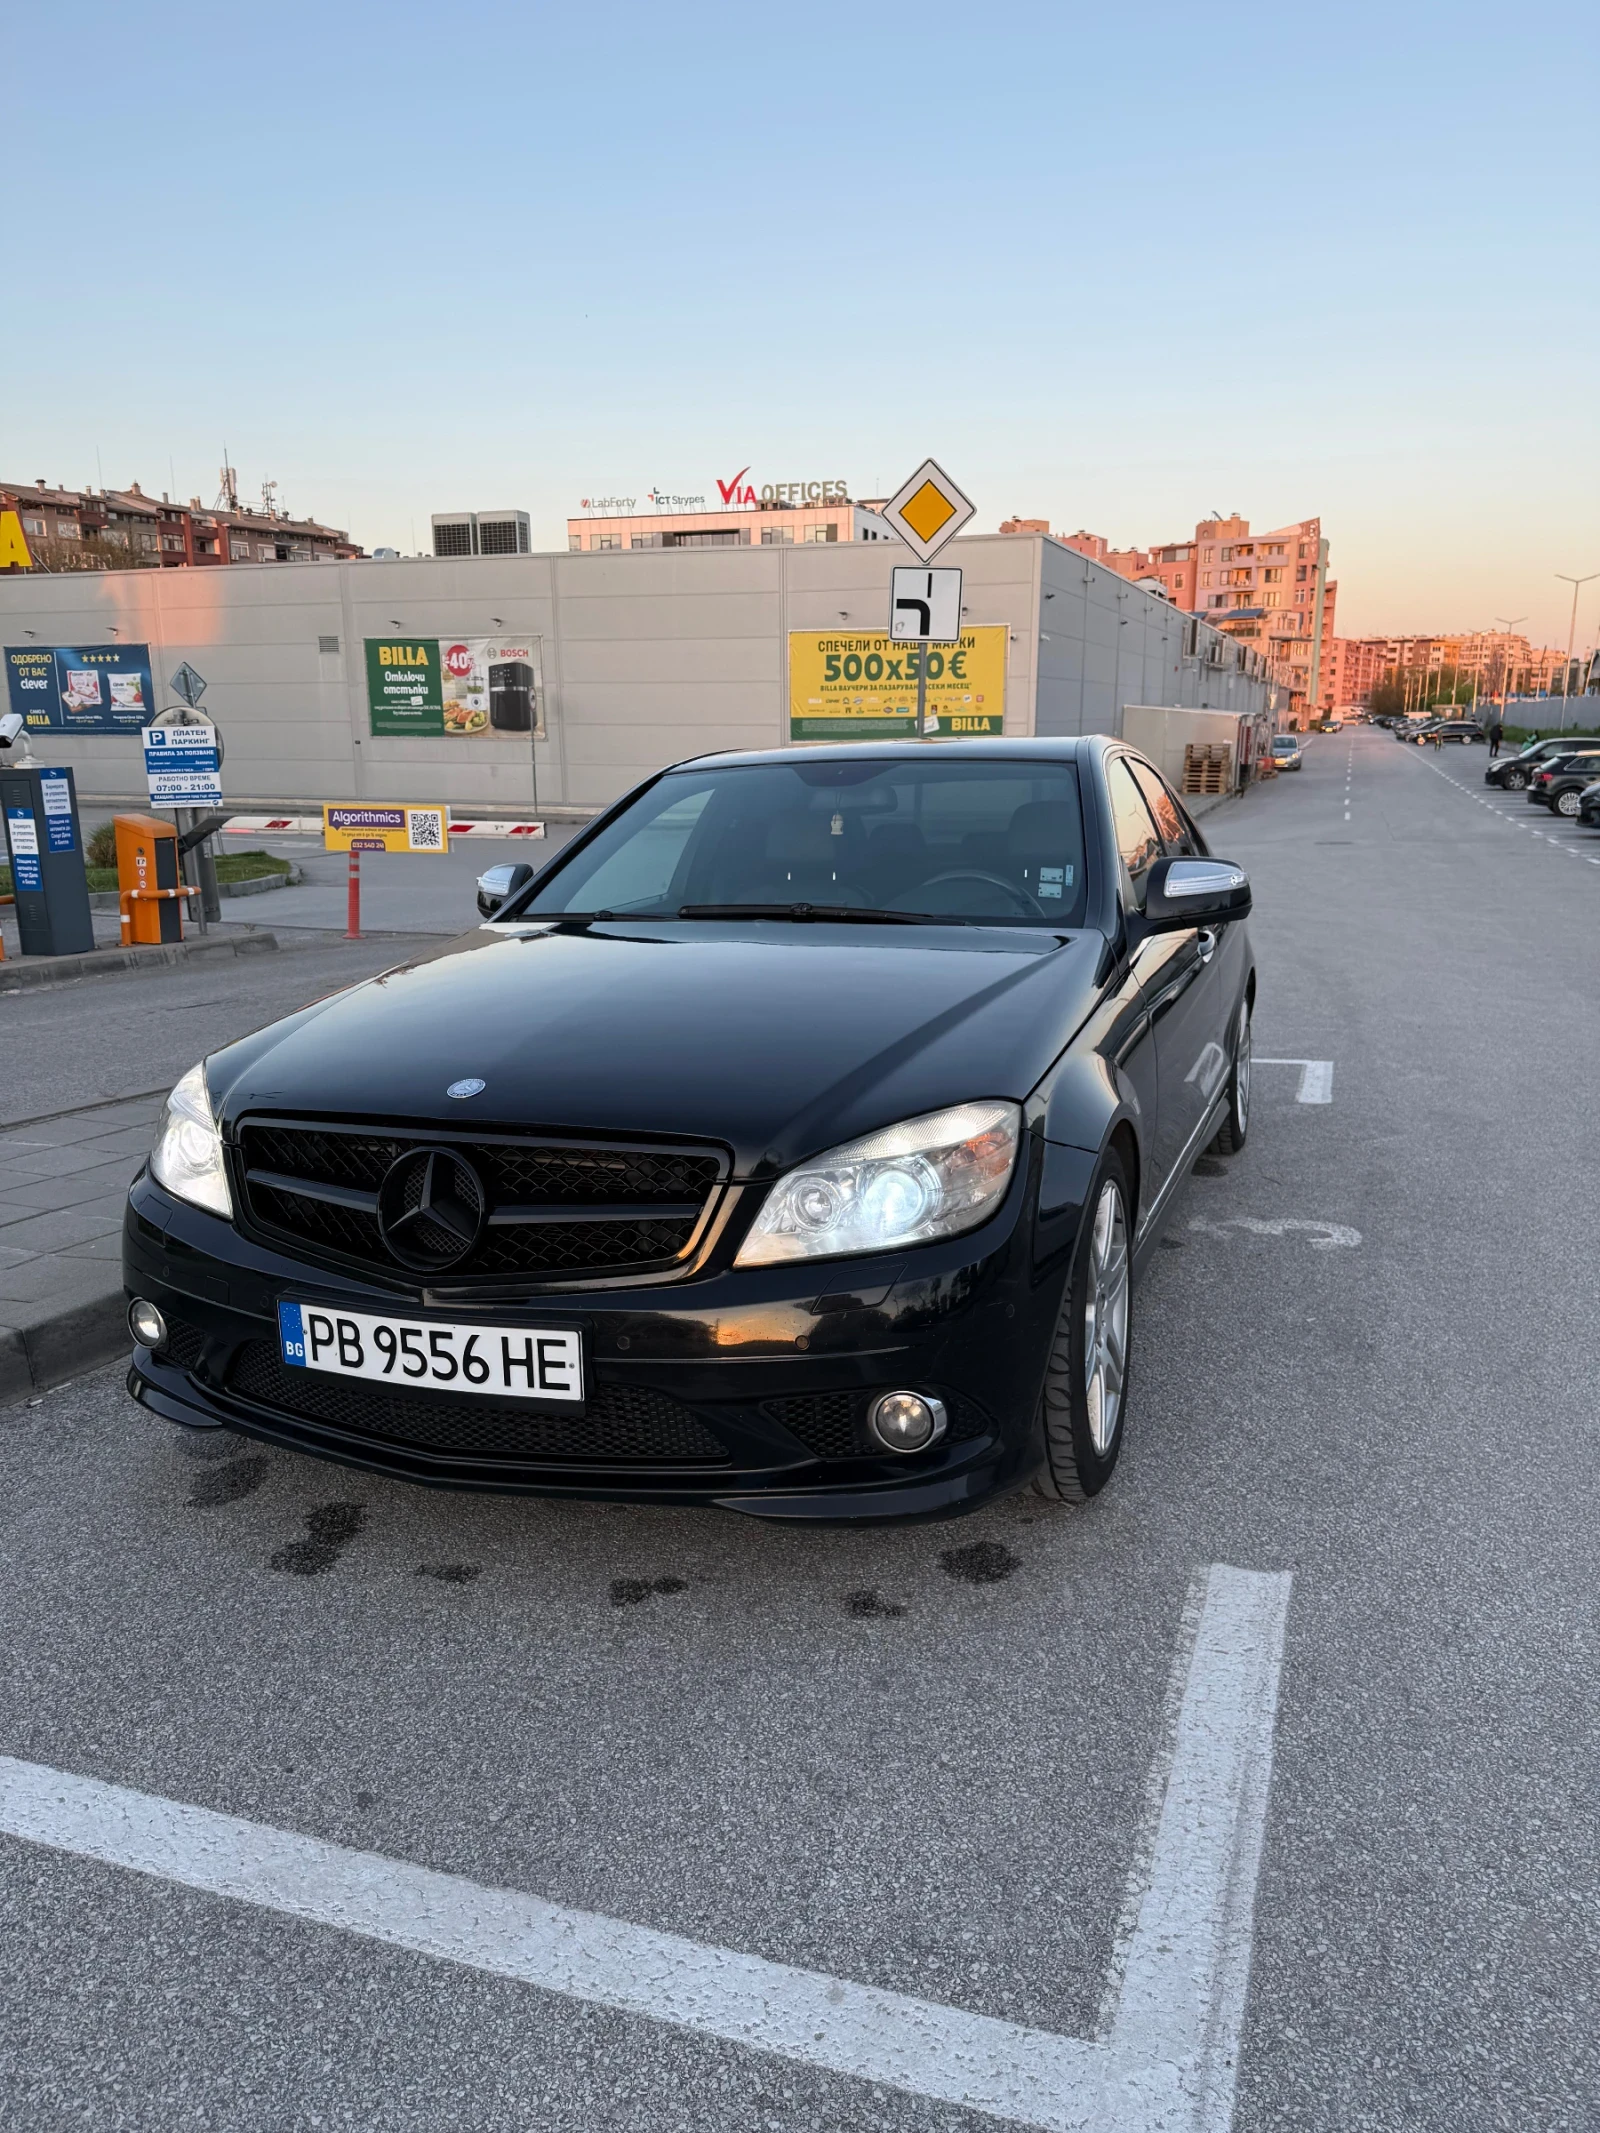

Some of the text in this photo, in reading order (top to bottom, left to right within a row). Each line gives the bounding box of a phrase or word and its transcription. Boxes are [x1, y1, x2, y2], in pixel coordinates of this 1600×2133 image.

[716, 466, 848, 505] VIA OFFICES
[591, 497, 637, 509] LabForty
[655, 494, 705, 506] ICT Strypes
[818, 639, 871, 652] СПЕЧЕЛИ
[874, 639, 889, 651] ОТ
[893, 641, 920, 651] НАШ
[11, 654, 52, 664] ОДОБРЕНО
[378, 646, 429, 666] BILLA
[500, 649, 529, 658] BOSCH
[19, 667, 47, 676] ОТ ВАС
[384, 670, 426, 682] Отключи
[20, 678, 48, 689] clever
[383, 684, 429, 695] отстъпки
[26, 715, 51, 725] BILLA
[951, 717, 991, 731] BILLA
[151, 732, 163, 744] P
[156, 784, 182, 792] 07:00
[190, 783, 216, 791] 21:00
[332, 811, 401, 825] Algorithmics
[286, 1341, 303, 1357] BG
[308, 1313, 571, 1391] PB 9556 HE
